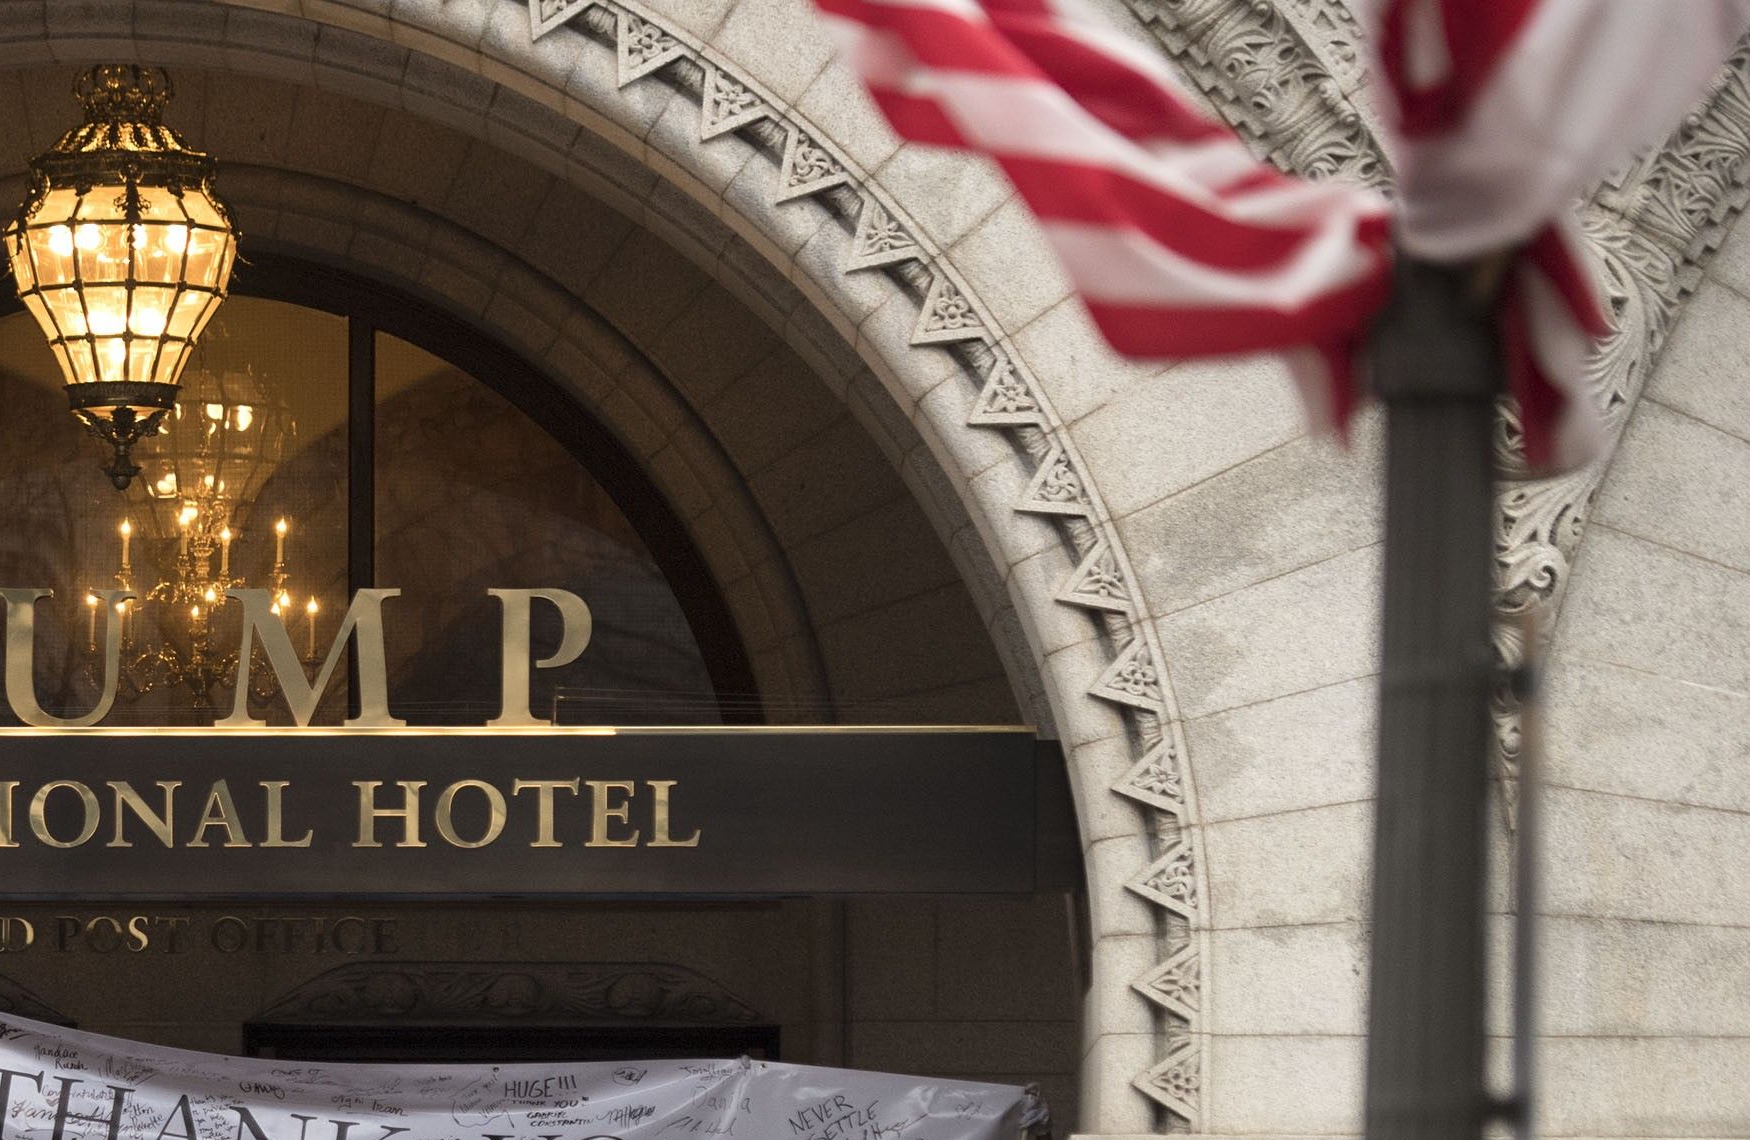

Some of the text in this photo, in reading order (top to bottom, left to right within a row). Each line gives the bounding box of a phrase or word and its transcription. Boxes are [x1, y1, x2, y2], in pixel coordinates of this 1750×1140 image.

[351, 779, 702, 850] HOTEL
[57, 915, 190, 953] POST
[211, 915, 401, 953] OFFICE
[787, 1094, 855, 1136] NEVER
